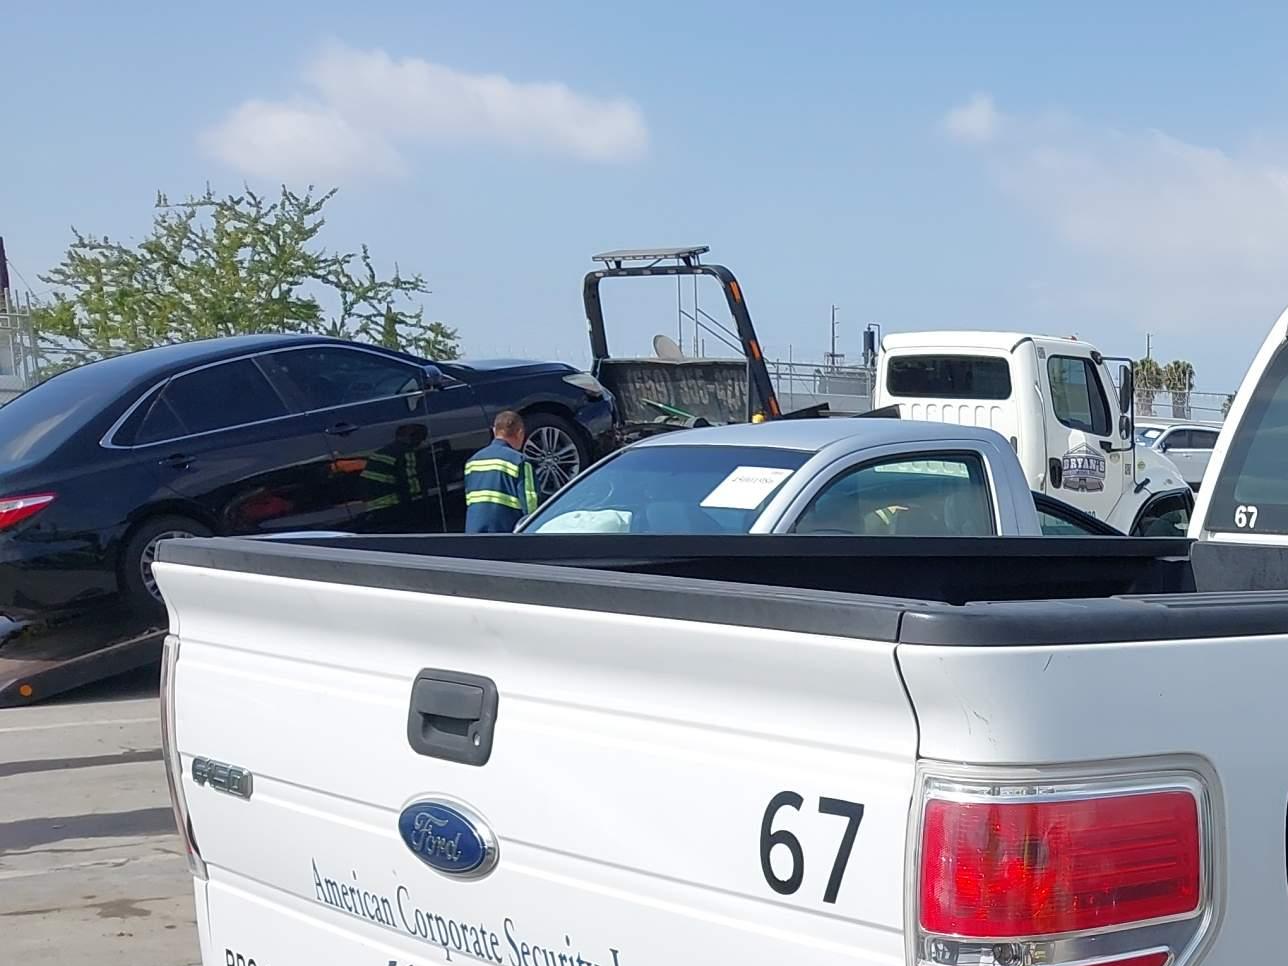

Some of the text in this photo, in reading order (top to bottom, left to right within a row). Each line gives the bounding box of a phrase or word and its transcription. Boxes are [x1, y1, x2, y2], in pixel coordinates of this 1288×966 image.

[1234, 504, 1258, 529] 67
[411, 811, 464, 862] Ford
[760, 791, 864, 904] 67
[312, 856, 397, 927] American
[396, 885, 502, 961] Corporate
